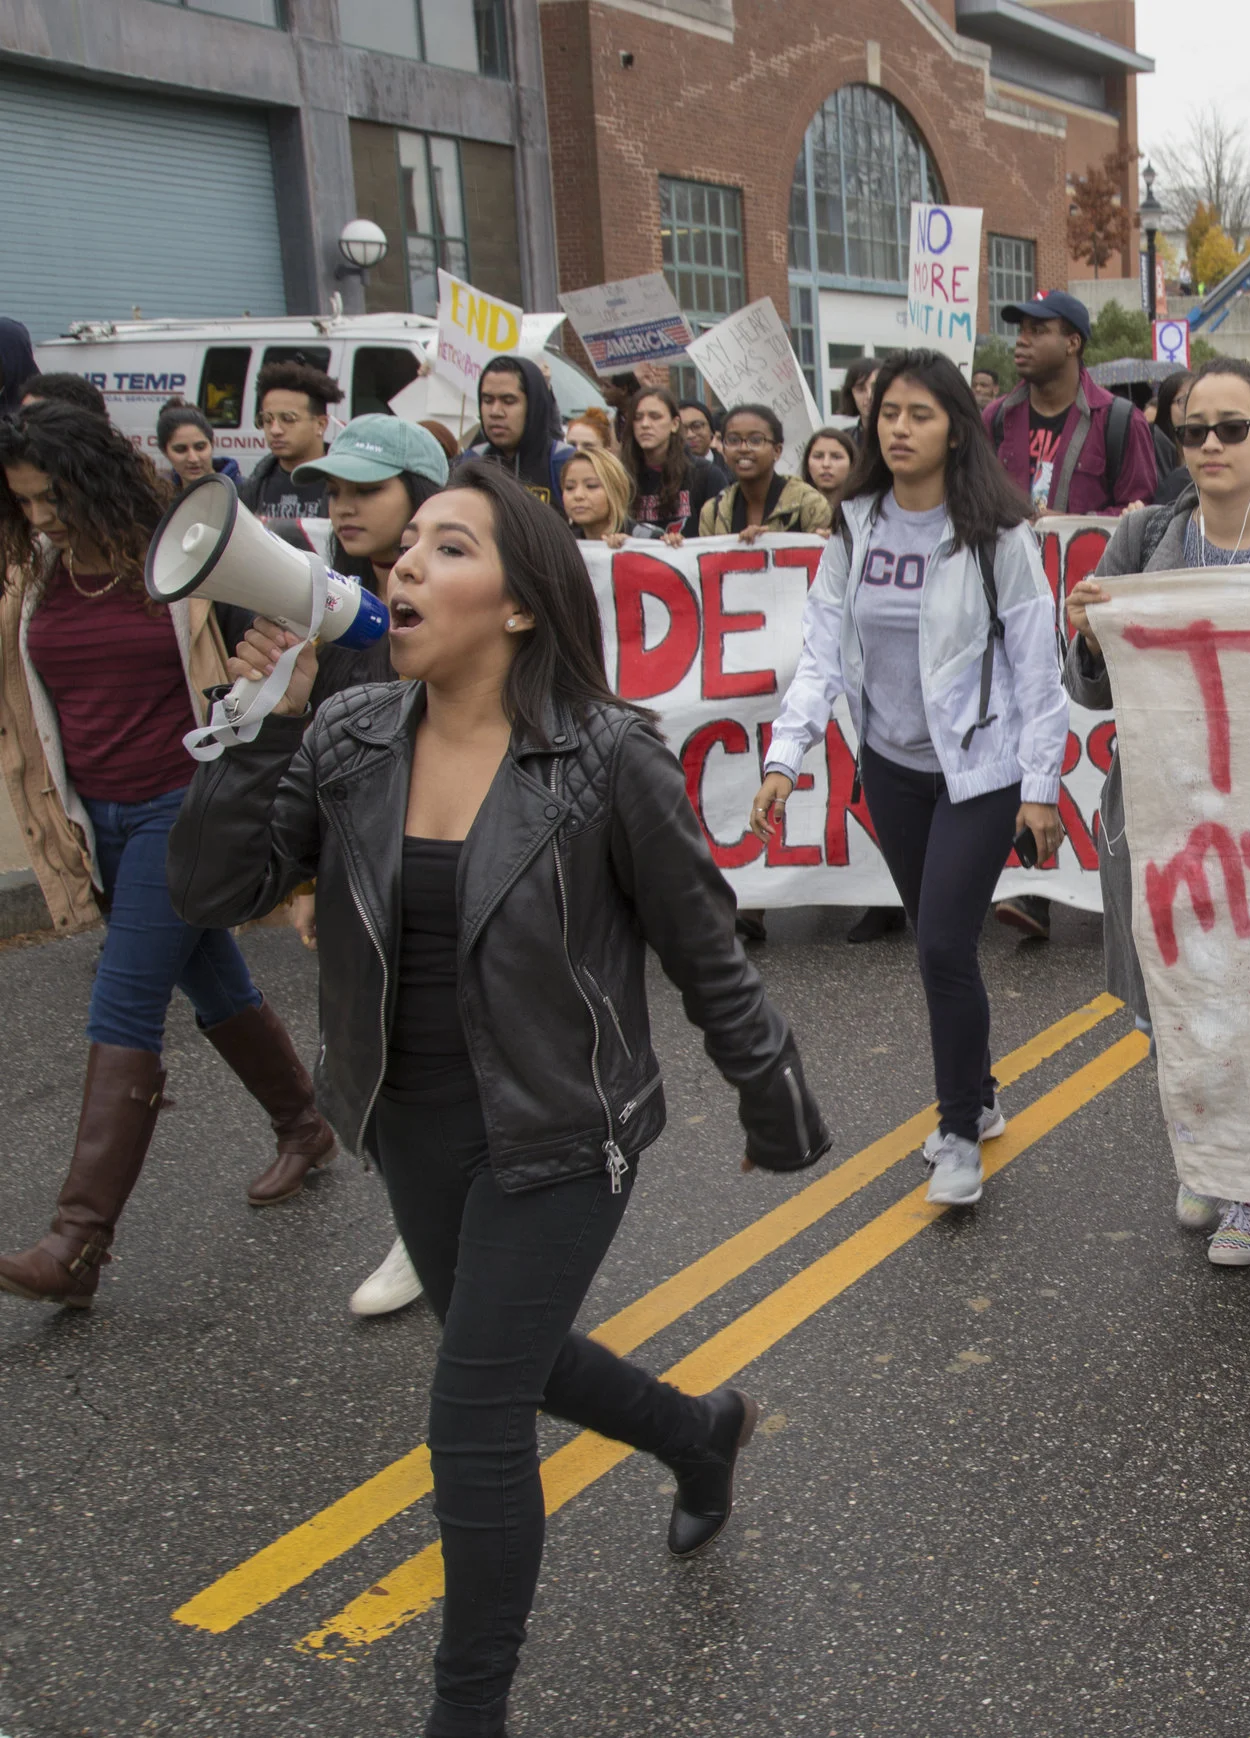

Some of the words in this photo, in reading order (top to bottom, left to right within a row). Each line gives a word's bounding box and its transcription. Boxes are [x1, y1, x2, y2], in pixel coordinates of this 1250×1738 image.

[917, 208, 953, 255] NO
[914, 263, 969, 303] MORE
[450, 281, 519, 352] END
[606, 330, 674, 358] AMERICA
[695, 336, 731, 377] MY
[728, 307, 773, 350] HEART
[113, 373, 187, 390] TEMP
[864, 548, 926, 590] CO
